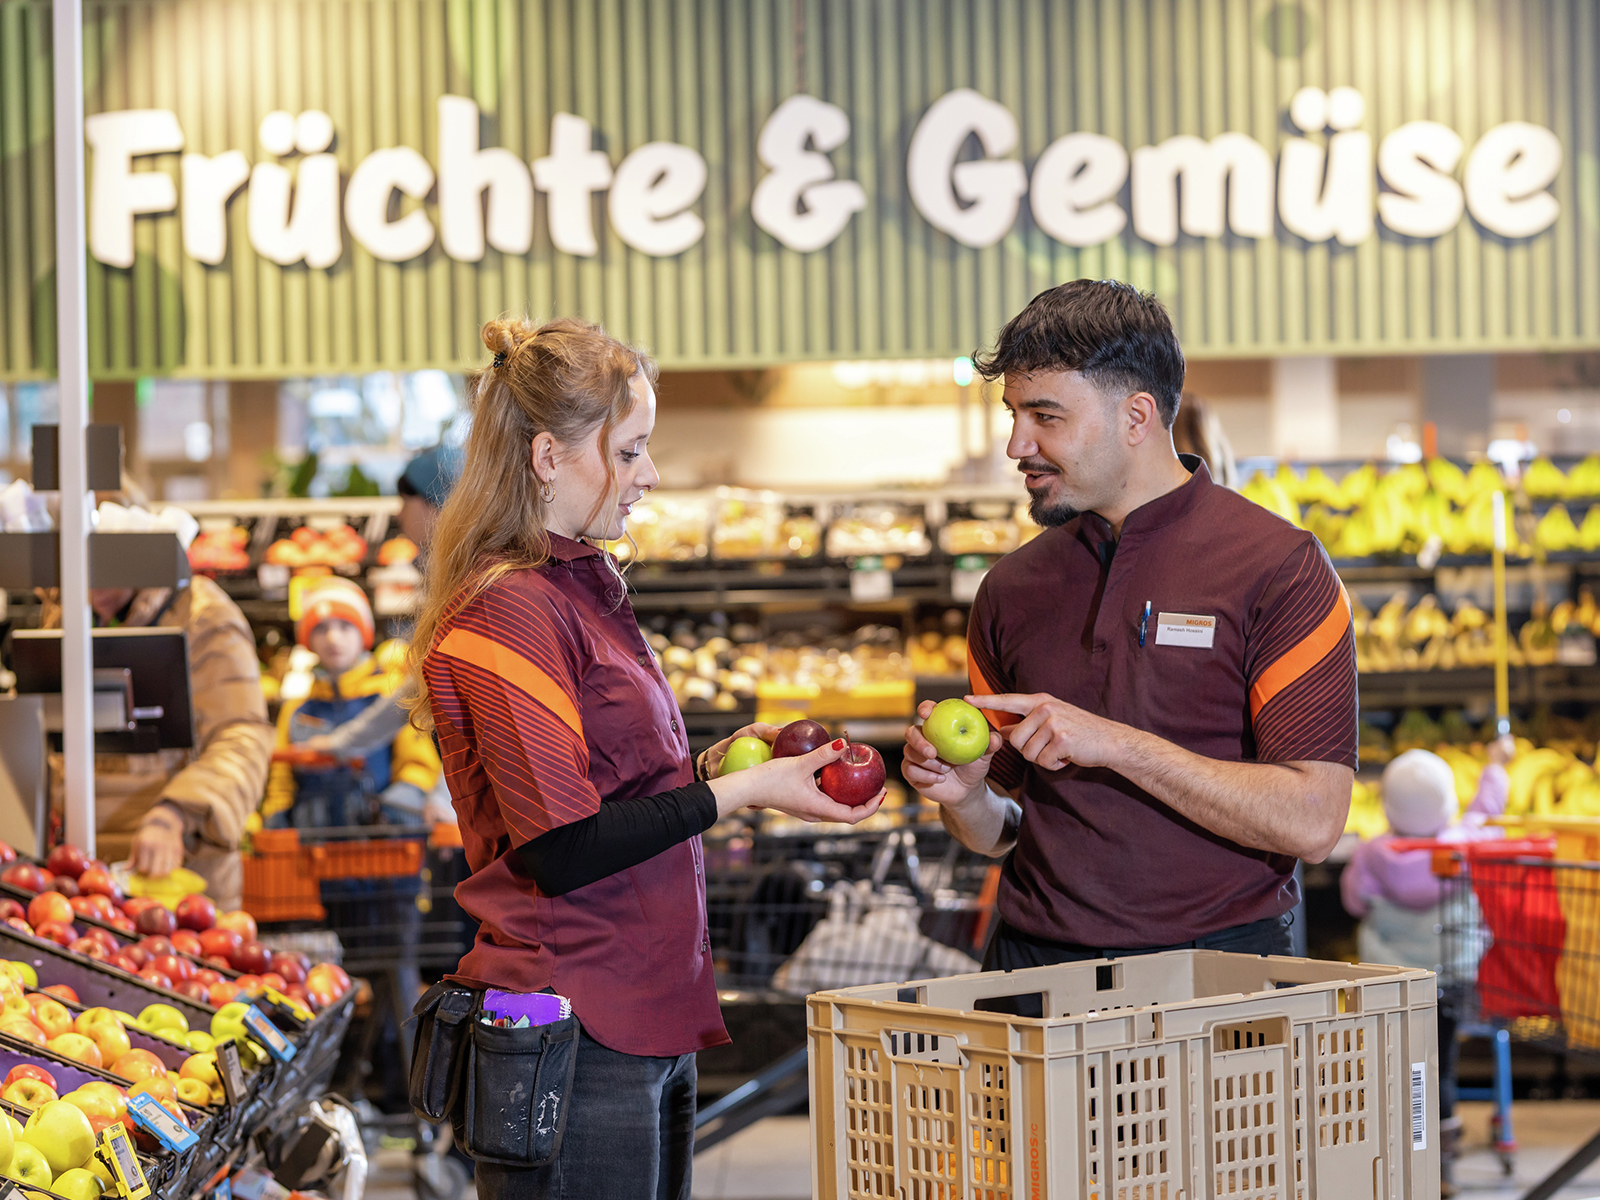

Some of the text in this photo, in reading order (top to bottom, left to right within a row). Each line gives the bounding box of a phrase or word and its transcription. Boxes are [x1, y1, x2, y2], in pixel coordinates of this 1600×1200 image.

[86, 86, 1563, 268] Früchte & Gemüse
[1186, 619, 1212, 627] MIGROS
[1030, 1123, 1040, 1200] MIGROS/C
